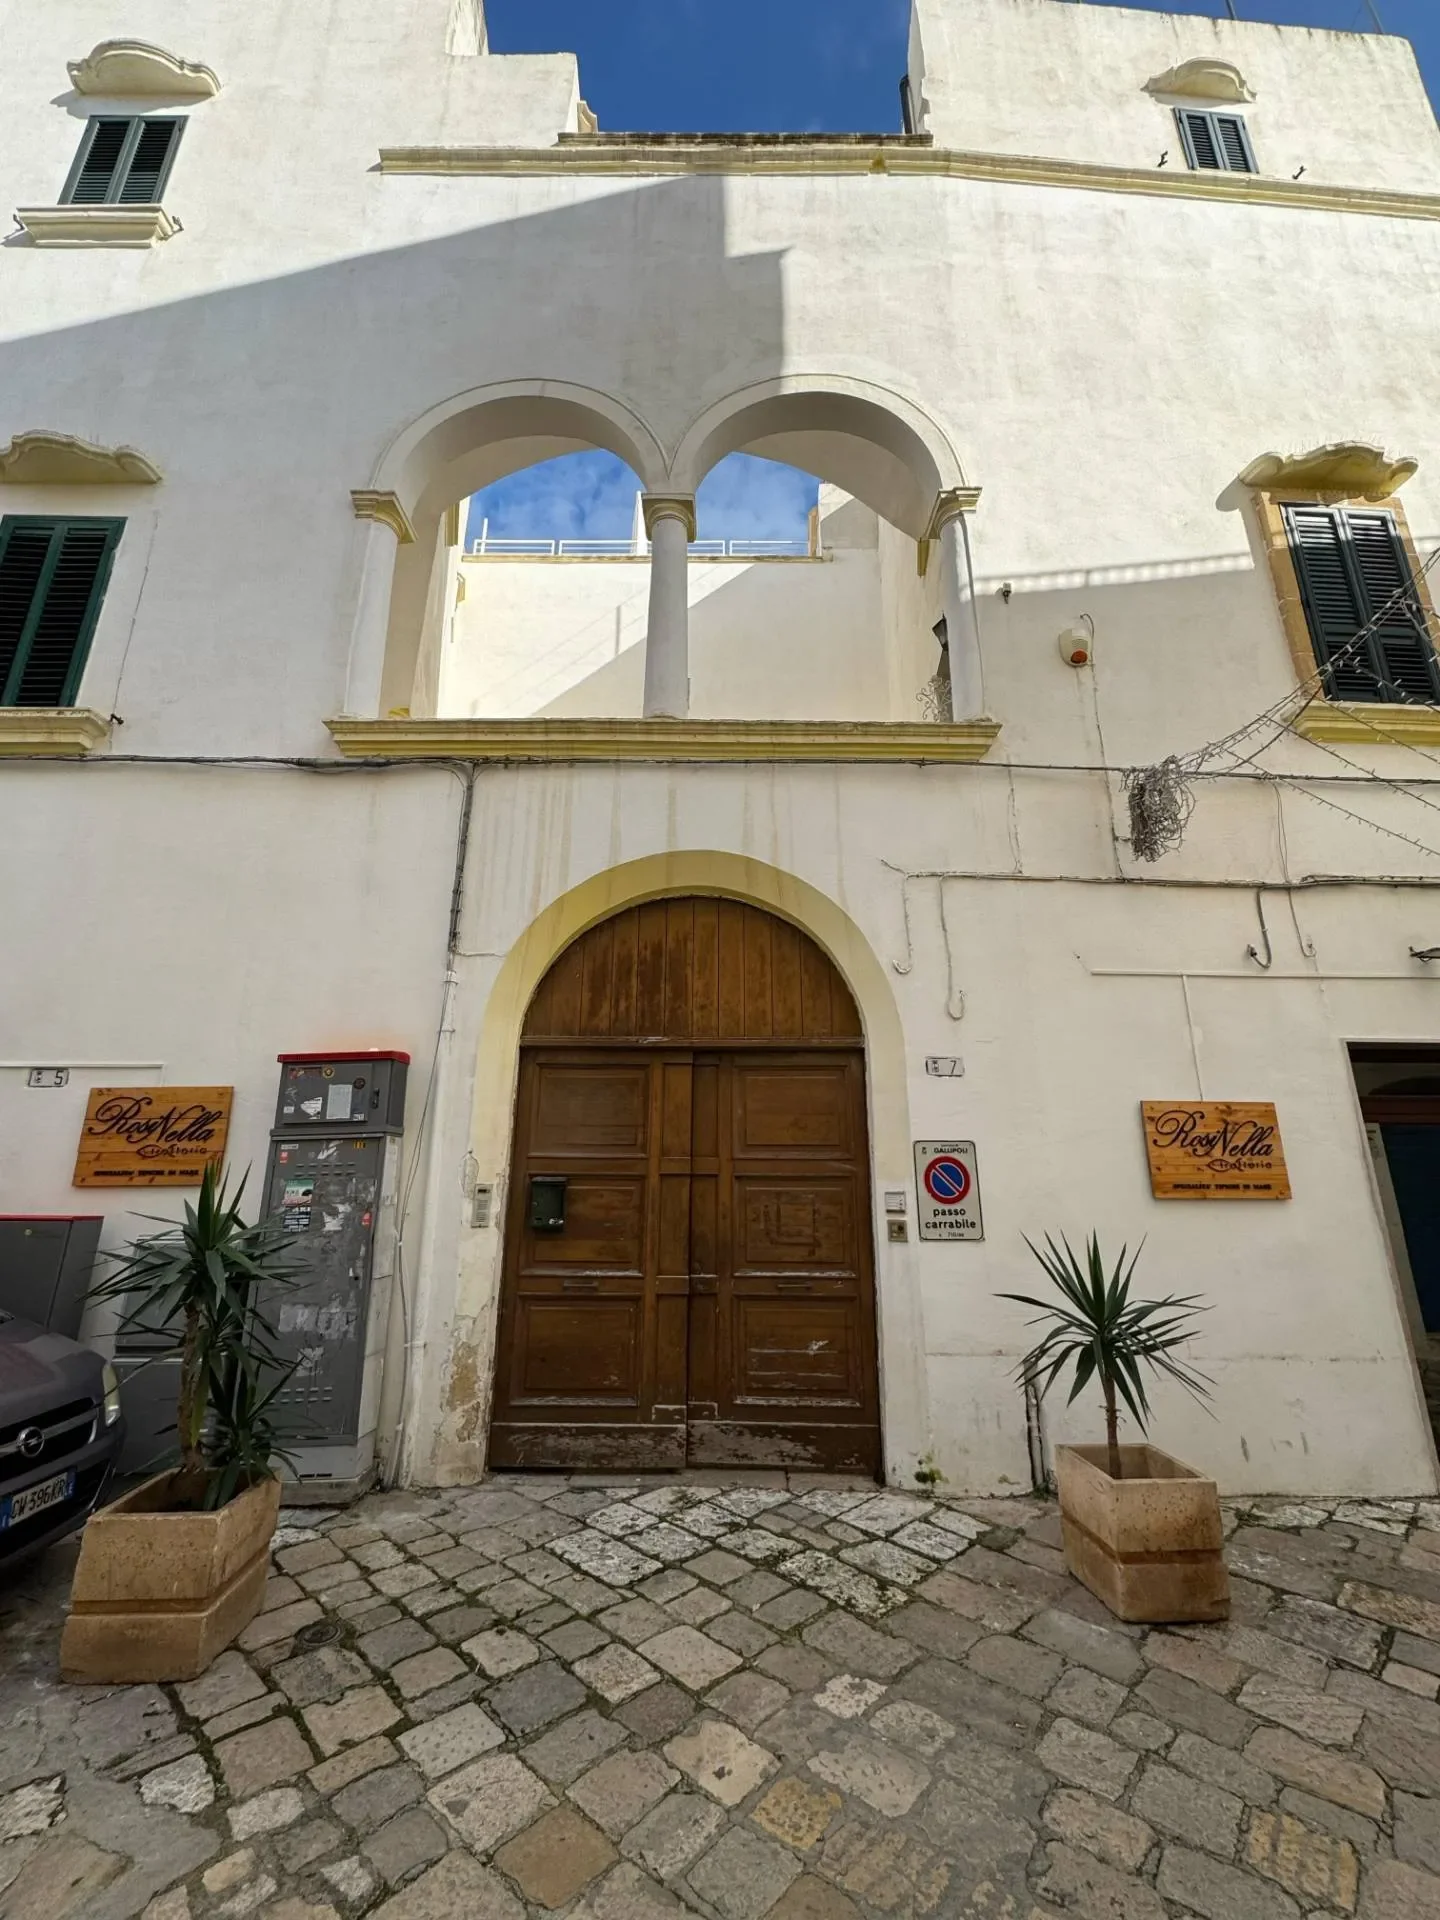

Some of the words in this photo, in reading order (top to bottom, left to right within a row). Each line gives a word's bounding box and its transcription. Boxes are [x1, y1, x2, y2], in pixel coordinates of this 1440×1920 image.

[949, 1060, 957, 1075] 7
[54, 1070, 63, 1085] 5
[932, 1208, 967, 1218] passo
[925, 1219, 977, 1229] carrabile
